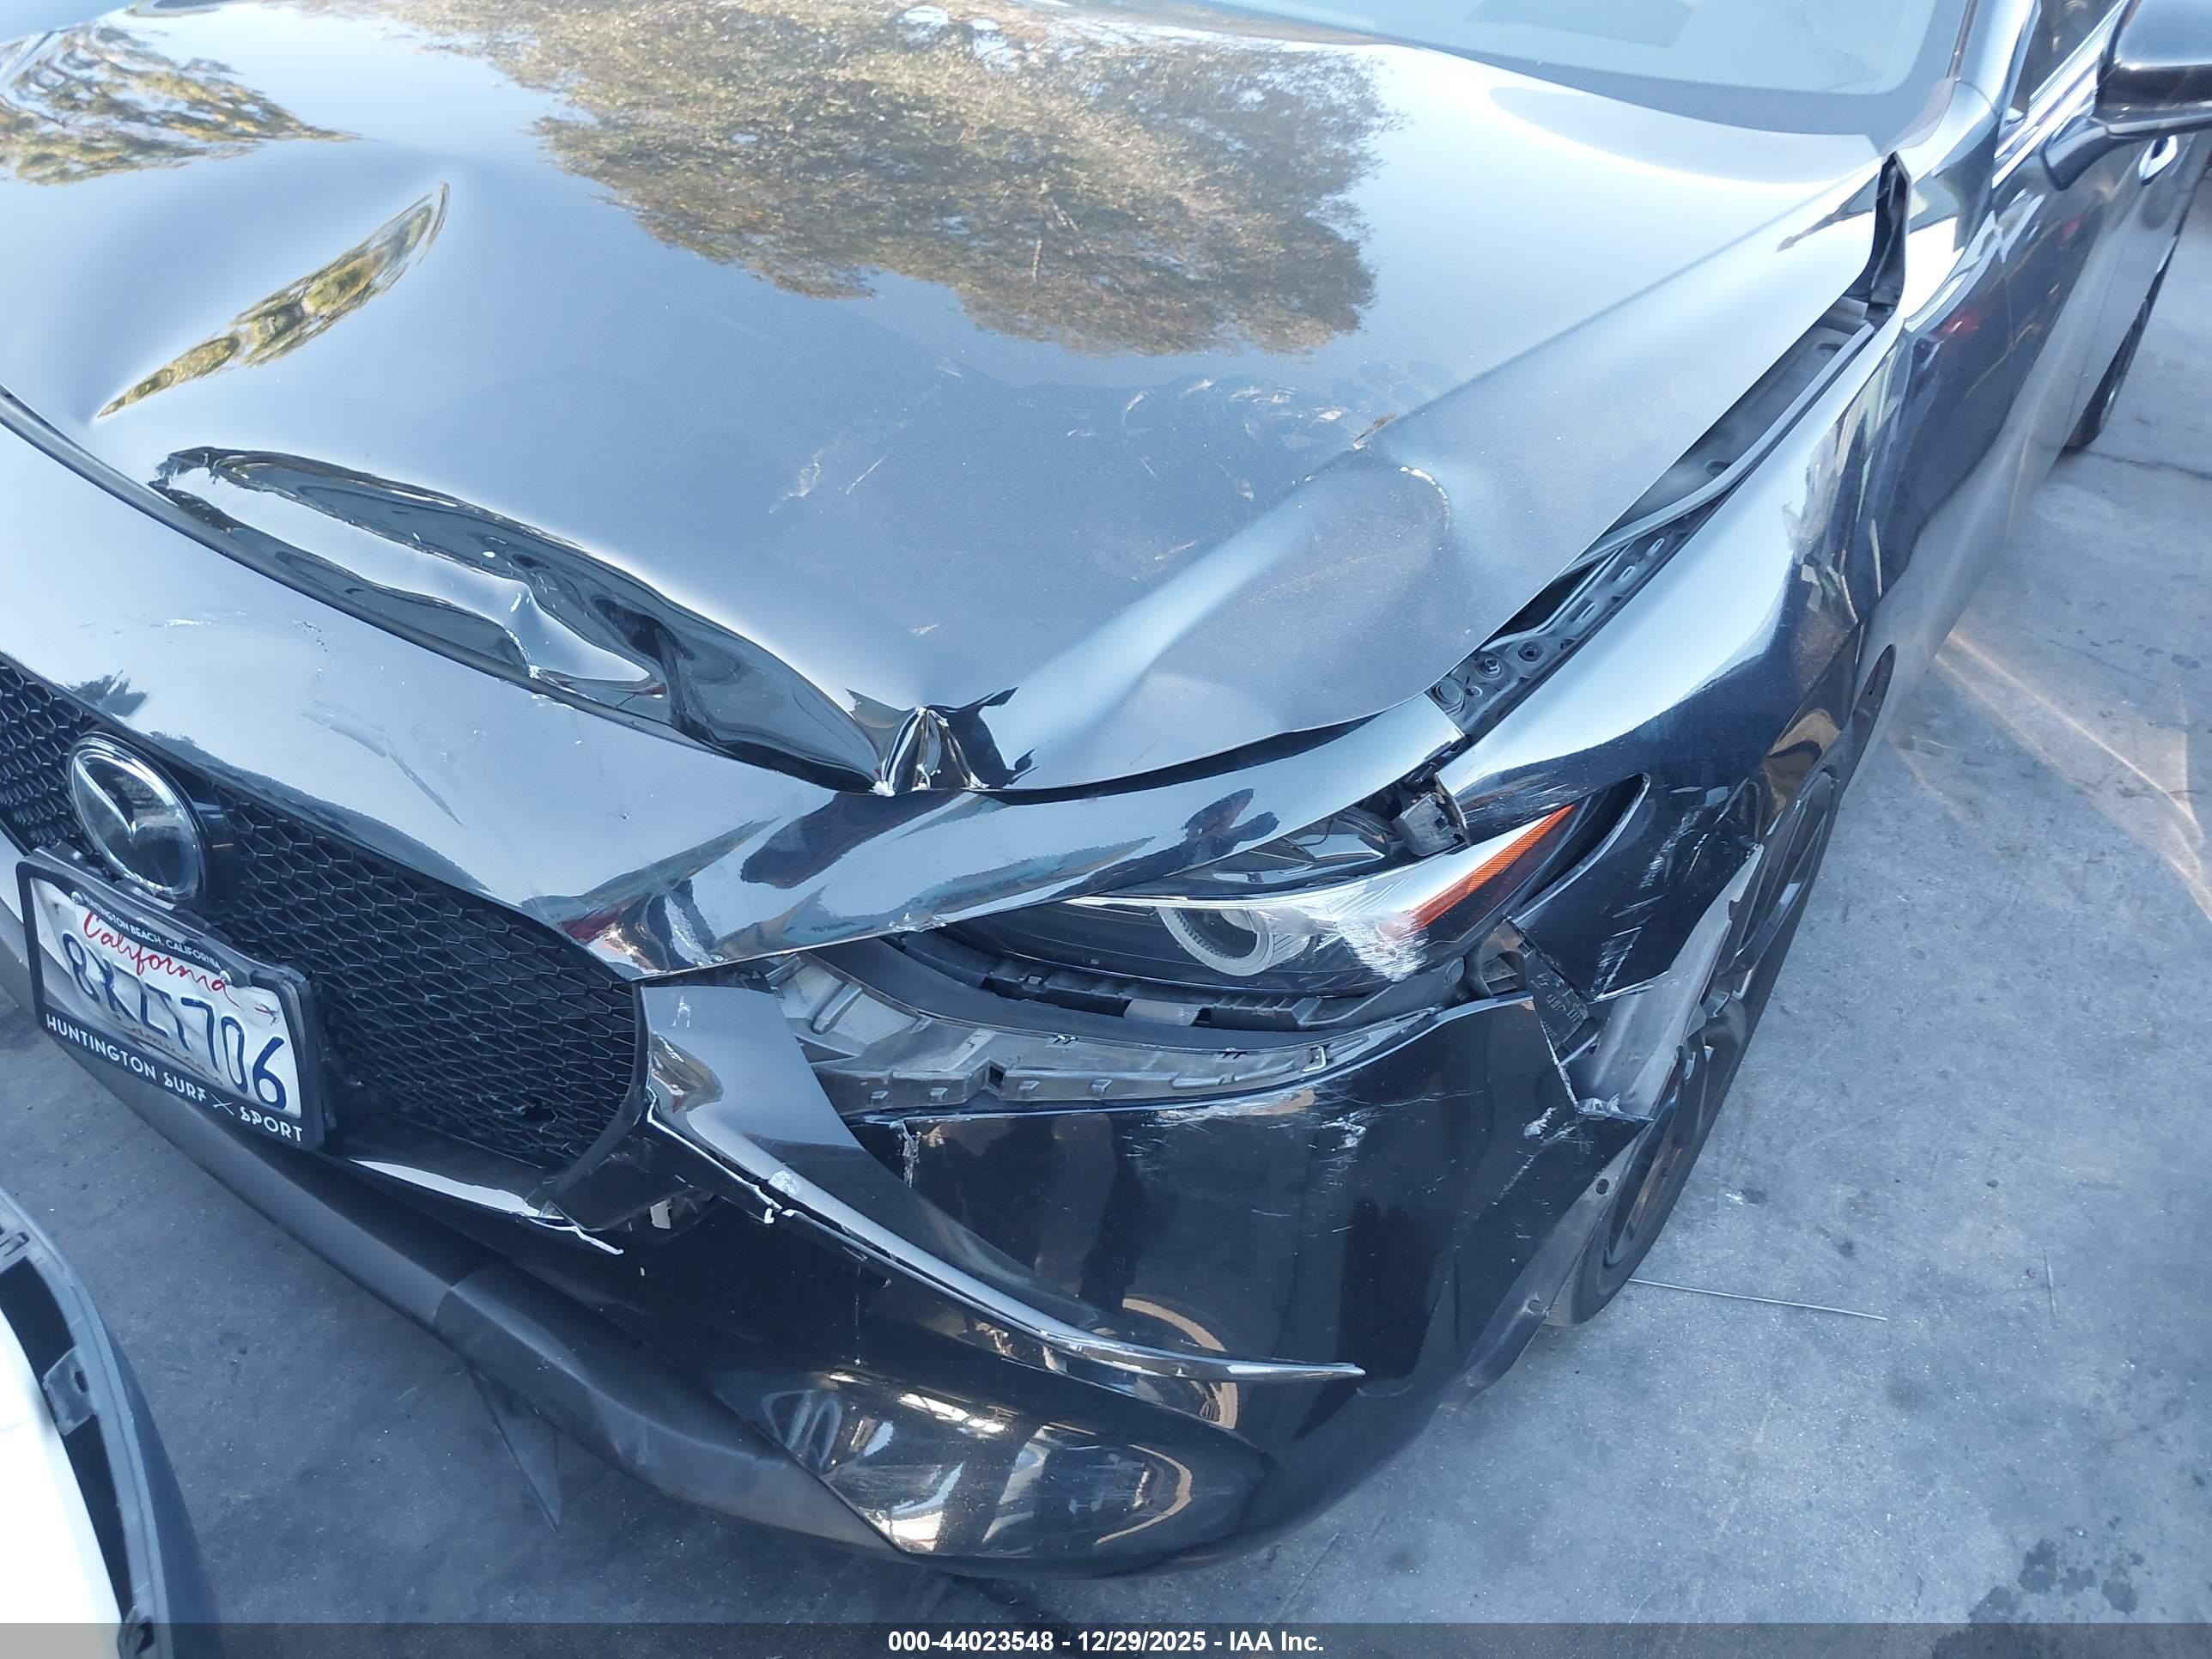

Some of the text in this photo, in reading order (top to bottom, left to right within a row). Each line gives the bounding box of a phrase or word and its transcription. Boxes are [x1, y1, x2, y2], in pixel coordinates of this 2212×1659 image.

[82, 893, 130, 931] NTINGTON
[83, 910, 245, 1011] California
[46, 1013, 156, 1080] HUNTINGTON
[163, 1072, 206, 1102] SURF
[240, 1106, 302, 1142] SPORT
